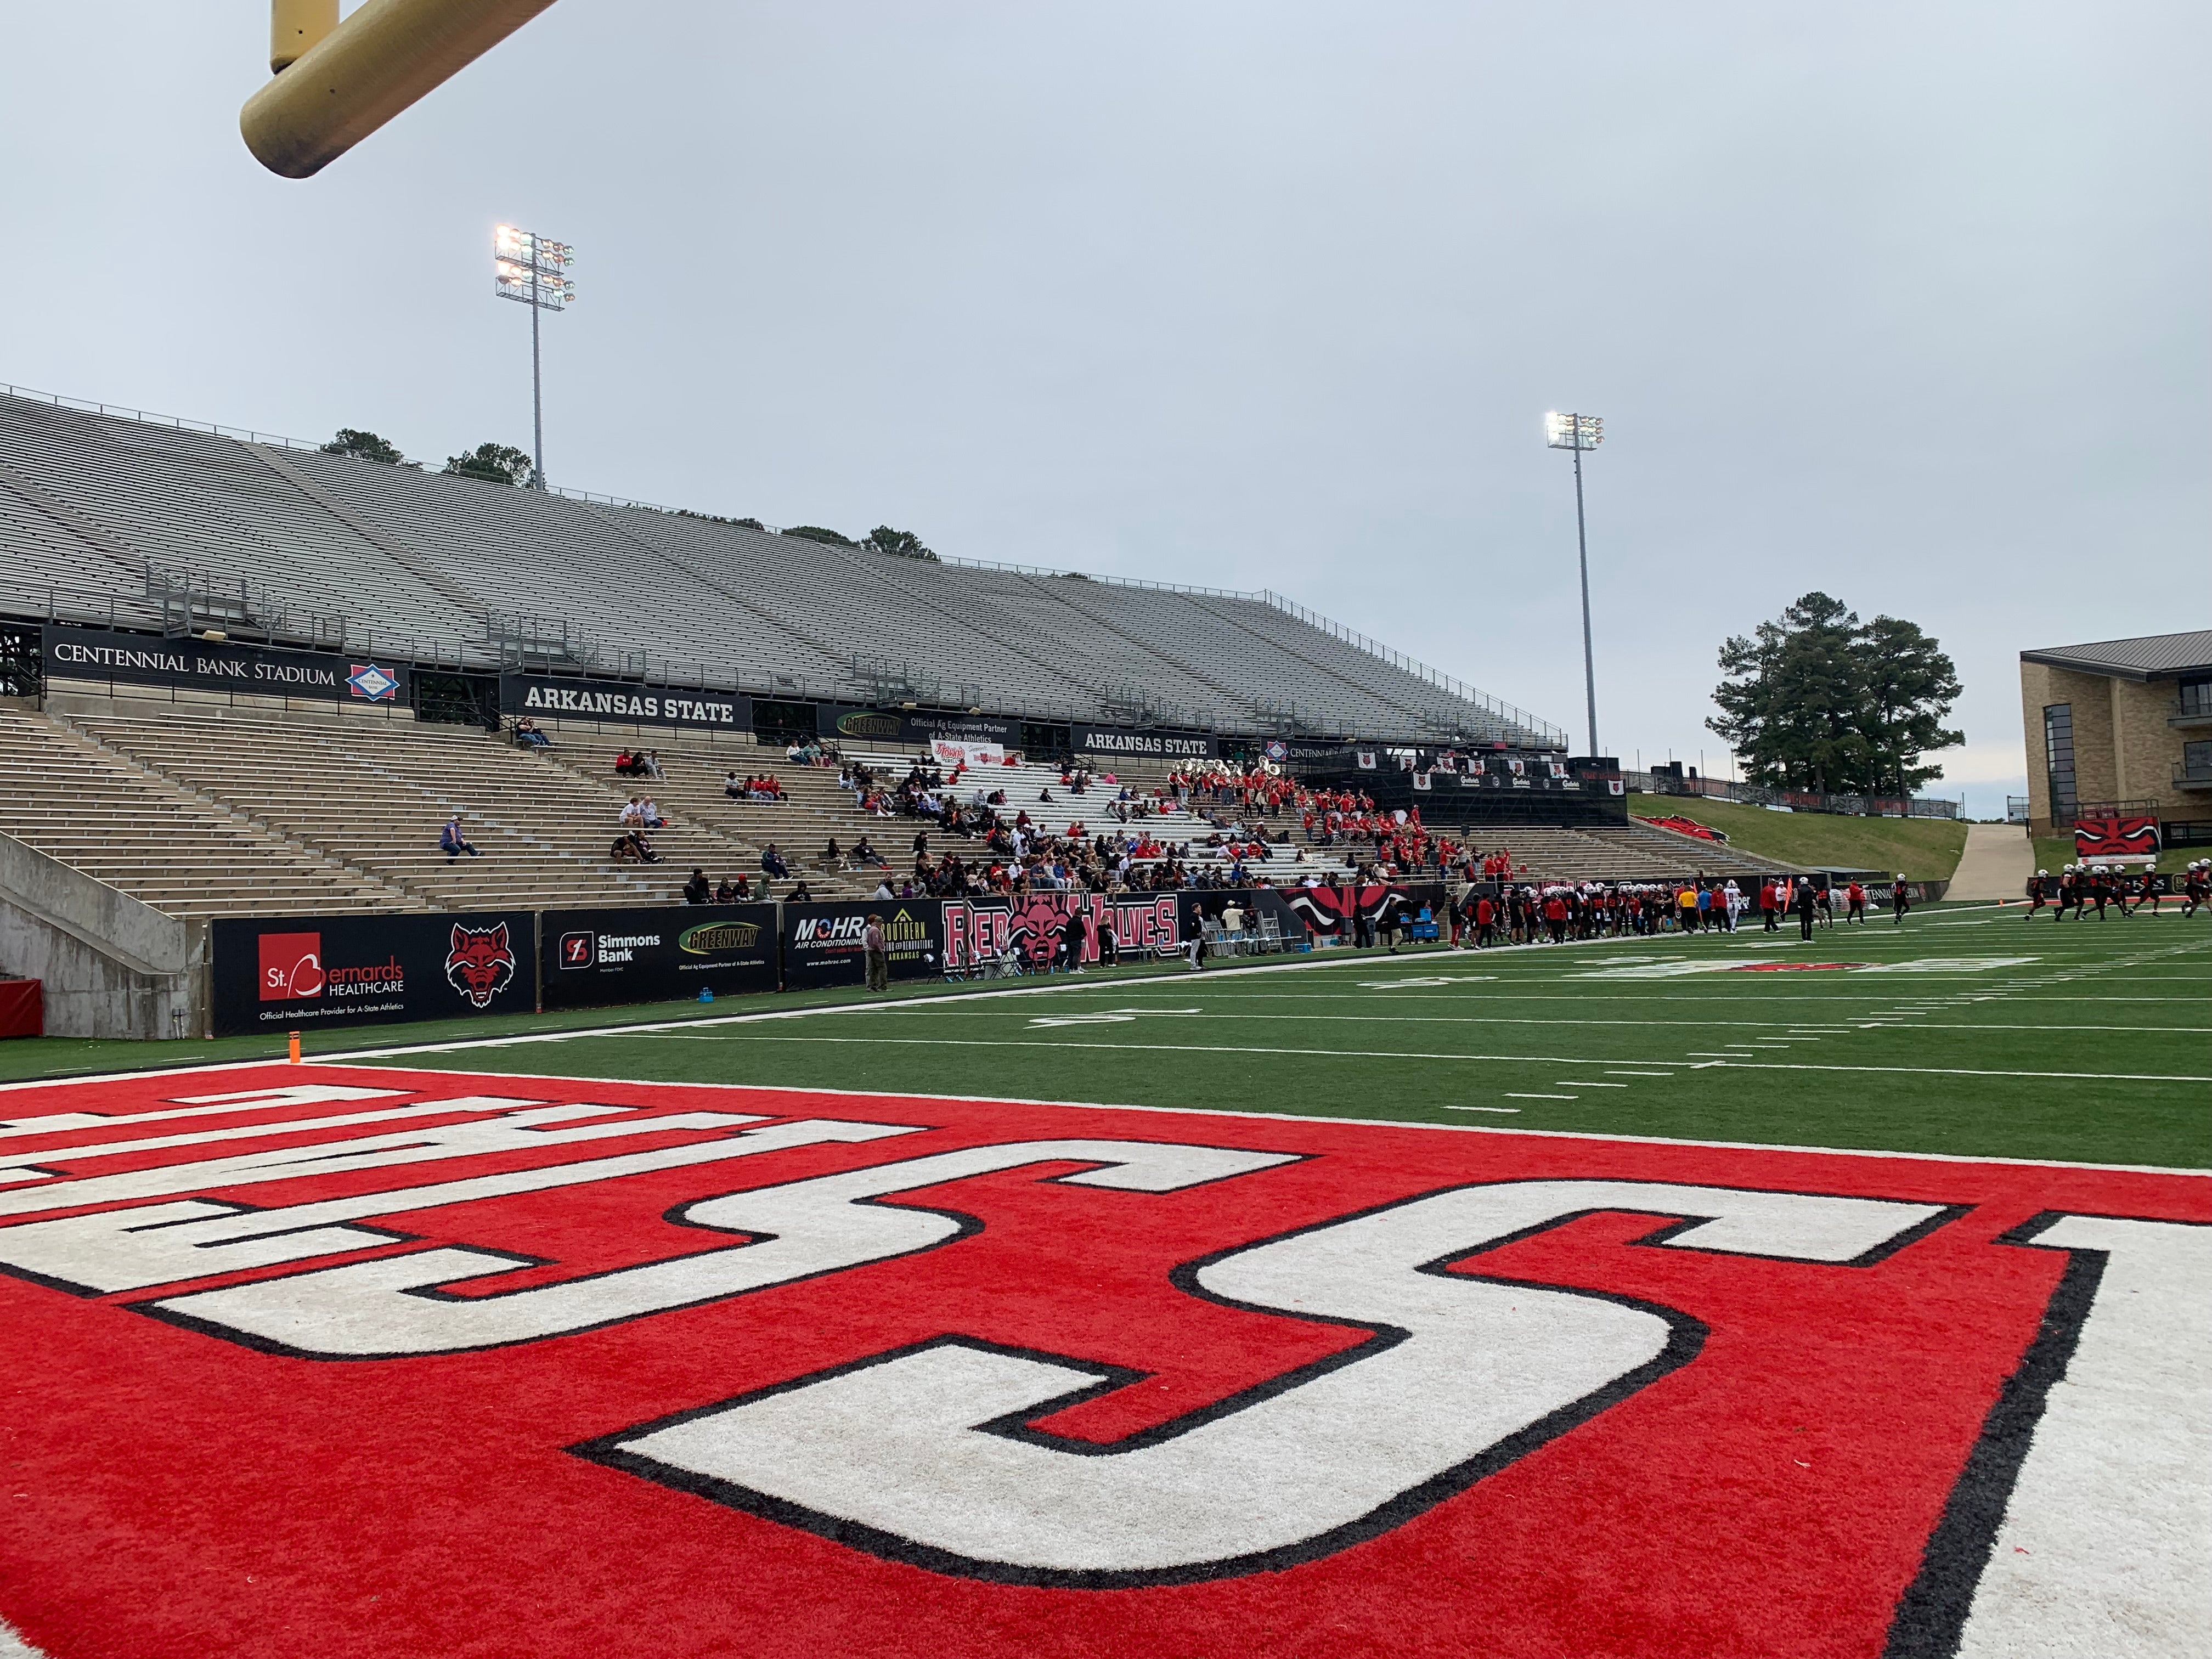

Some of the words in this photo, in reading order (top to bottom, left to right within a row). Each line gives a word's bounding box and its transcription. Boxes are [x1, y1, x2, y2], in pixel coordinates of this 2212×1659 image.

[55, 644, 189, 672] CENTENNIAL
[196, 657, 249, 678] BANK
[254, 663, 336, 686] STADIUM
[524, 687, 658, 716] ARKANSAS
[664, 699, 734, 723] STATE
[845, 716, 901, 735] GREENWAY
[911, 718, 935, 727] Official
[937, 720, 946, 730] Ag
[947, 720, 983, 732] Equipment
[984, 724, 1007, 733] Partner
[929, 731, 935, 740] of
[938, 732, 962, 741] A-State
[963, 733, 992, 743] Athletics
[1085, 733, 1161, 754] ARKANSAS
[1165, 738, 1207, 755] STATE
[1290, 748, 1331, 758] CENTENNIAL
[794, 916, 865, 941] MOHR
[881, 922, 926, 941] SOUTHERN
[945, 906, 1009, 967] RED
[598, 934, 661, 949] Simmons
[690, 928, 759, 950] GREENWAY
[794, 941, 809, 950] AIR
[811, 938, 864, 949] CONDITIONING
[903, 939, 933, 951] RENOVATIONS
[598, 948, 633, 963] Bank
[889, 951, 919, 961] ARKANSAS
[267, 967, 287, 988] St.
[329, 980, 404, 996] HEALTHCARE
[259, 1011, 284, 1020] Official
[286, 1009, 319, 1018] Healthcare
[320, 1007, 346, 1015] Provider
[347, 1006, 356, 1014] for
[357, 1004, 379, 1013] A-State
[380, 1002, 404, 1011] Athletics
